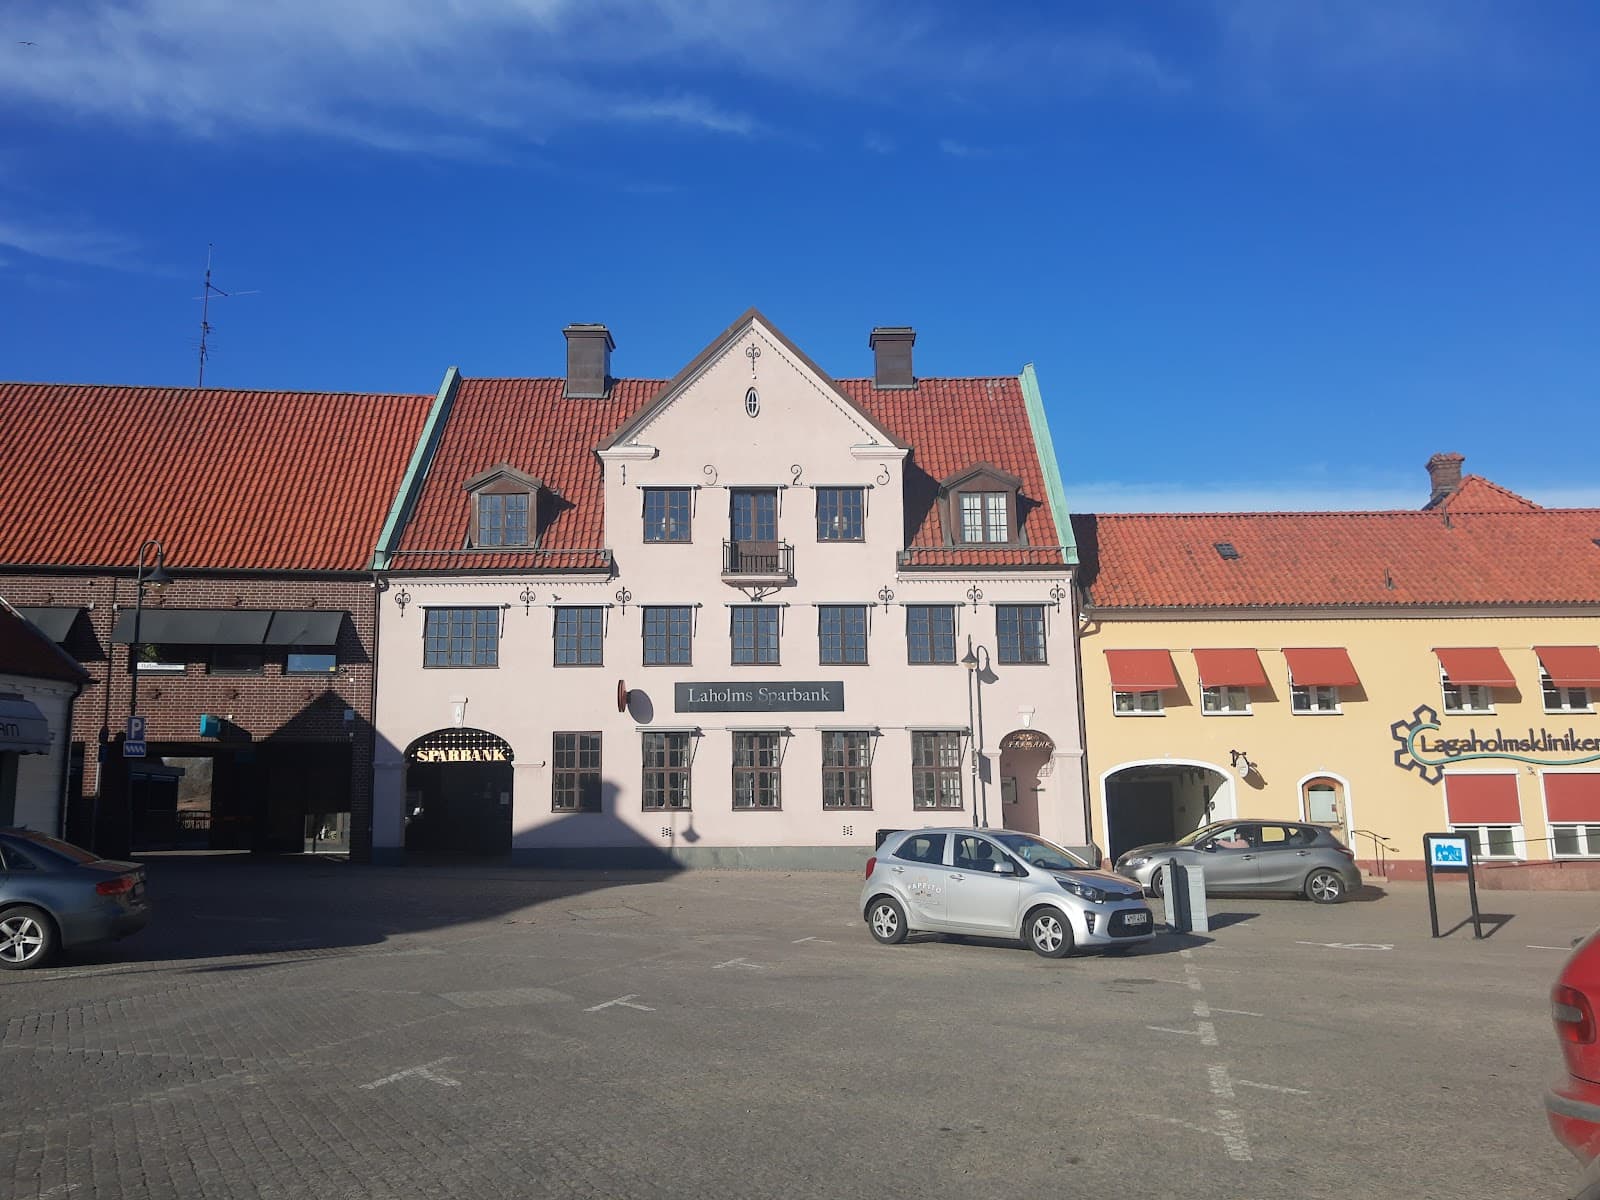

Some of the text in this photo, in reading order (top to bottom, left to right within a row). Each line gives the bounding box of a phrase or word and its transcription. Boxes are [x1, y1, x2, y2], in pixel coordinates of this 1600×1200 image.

[703, 464, 718, 486] 9
[790, 464, 803, 486] 2
[876, 463, 891, 486] 3
[688, 687, 831, 705] Laholms Sparbank
[131, 718, 142, 739] P
[416, 749, 507, 762] SPARBANK
